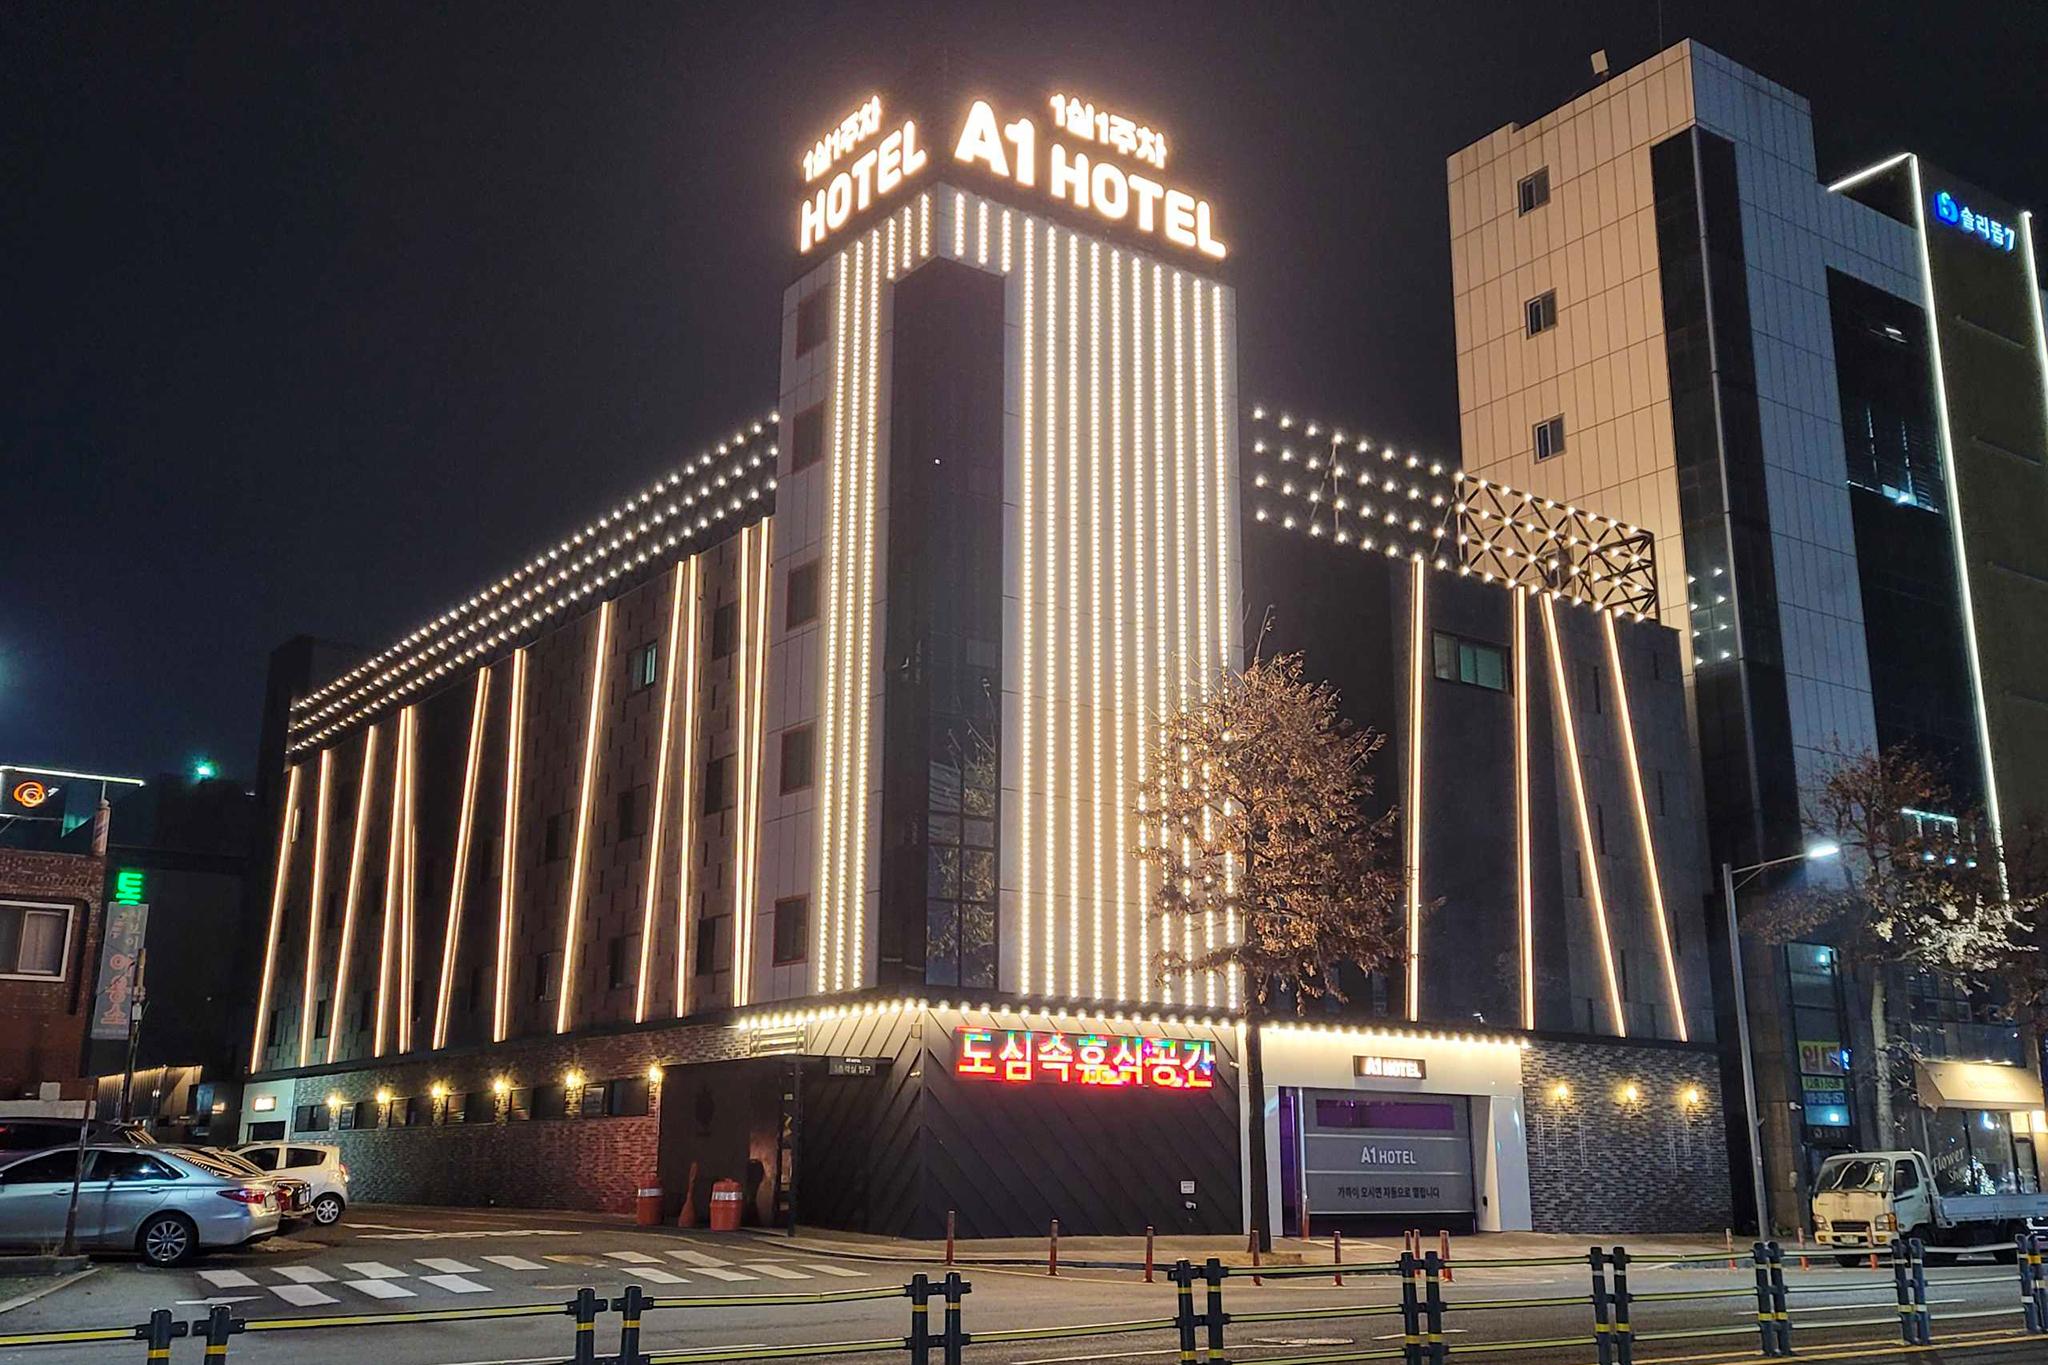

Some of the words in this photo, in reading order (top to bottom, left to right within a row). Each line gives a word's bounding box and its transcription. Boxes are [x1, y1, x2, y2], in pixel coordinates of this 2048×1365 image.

[799, 120, 927, 254] HOTEL
[954, 101, 1036, 187] A1
[1050, 144, 1227, 259] HOTEL
[1365, 1057, 1382, 1076] A1
[1383, 1060, 1422, 1078] HOTEL
[1360, 1146, 1377, 1164] A1
[1379, 1149, 1417, 1165] HOTEL
[1361, 1186, 1382, 1199] 오시면
